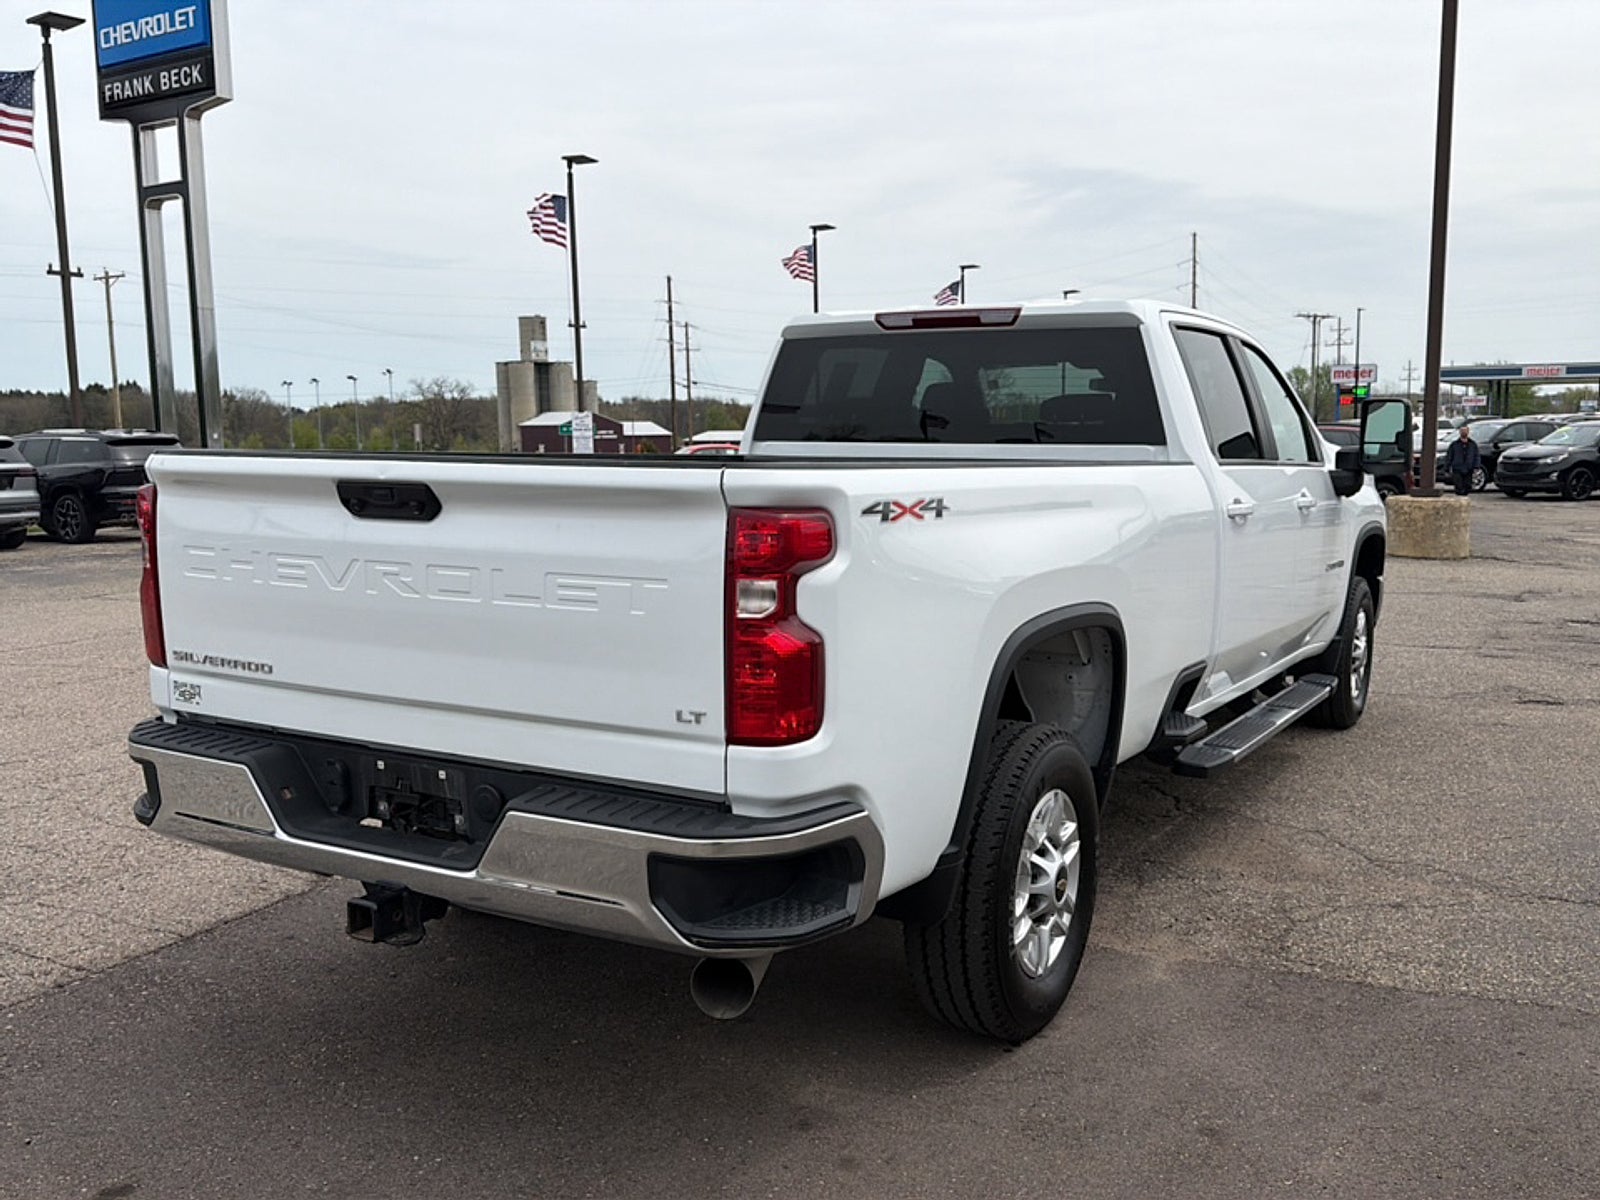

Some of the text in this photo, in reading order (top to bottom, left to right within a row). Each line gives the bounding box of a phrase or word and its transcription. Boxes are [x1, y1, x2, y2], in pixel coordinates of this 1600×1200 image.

[100, 5, 197, 48] CHEVROLET
[104, 64, 202, 103] FRANK BECK
[1333, 369, 1373, 379] meier
[183, 545, 668, 615] CHEVROLET
[172, 650, 273, 674] SILVERADO
[675, 709, 707, 725] LT
